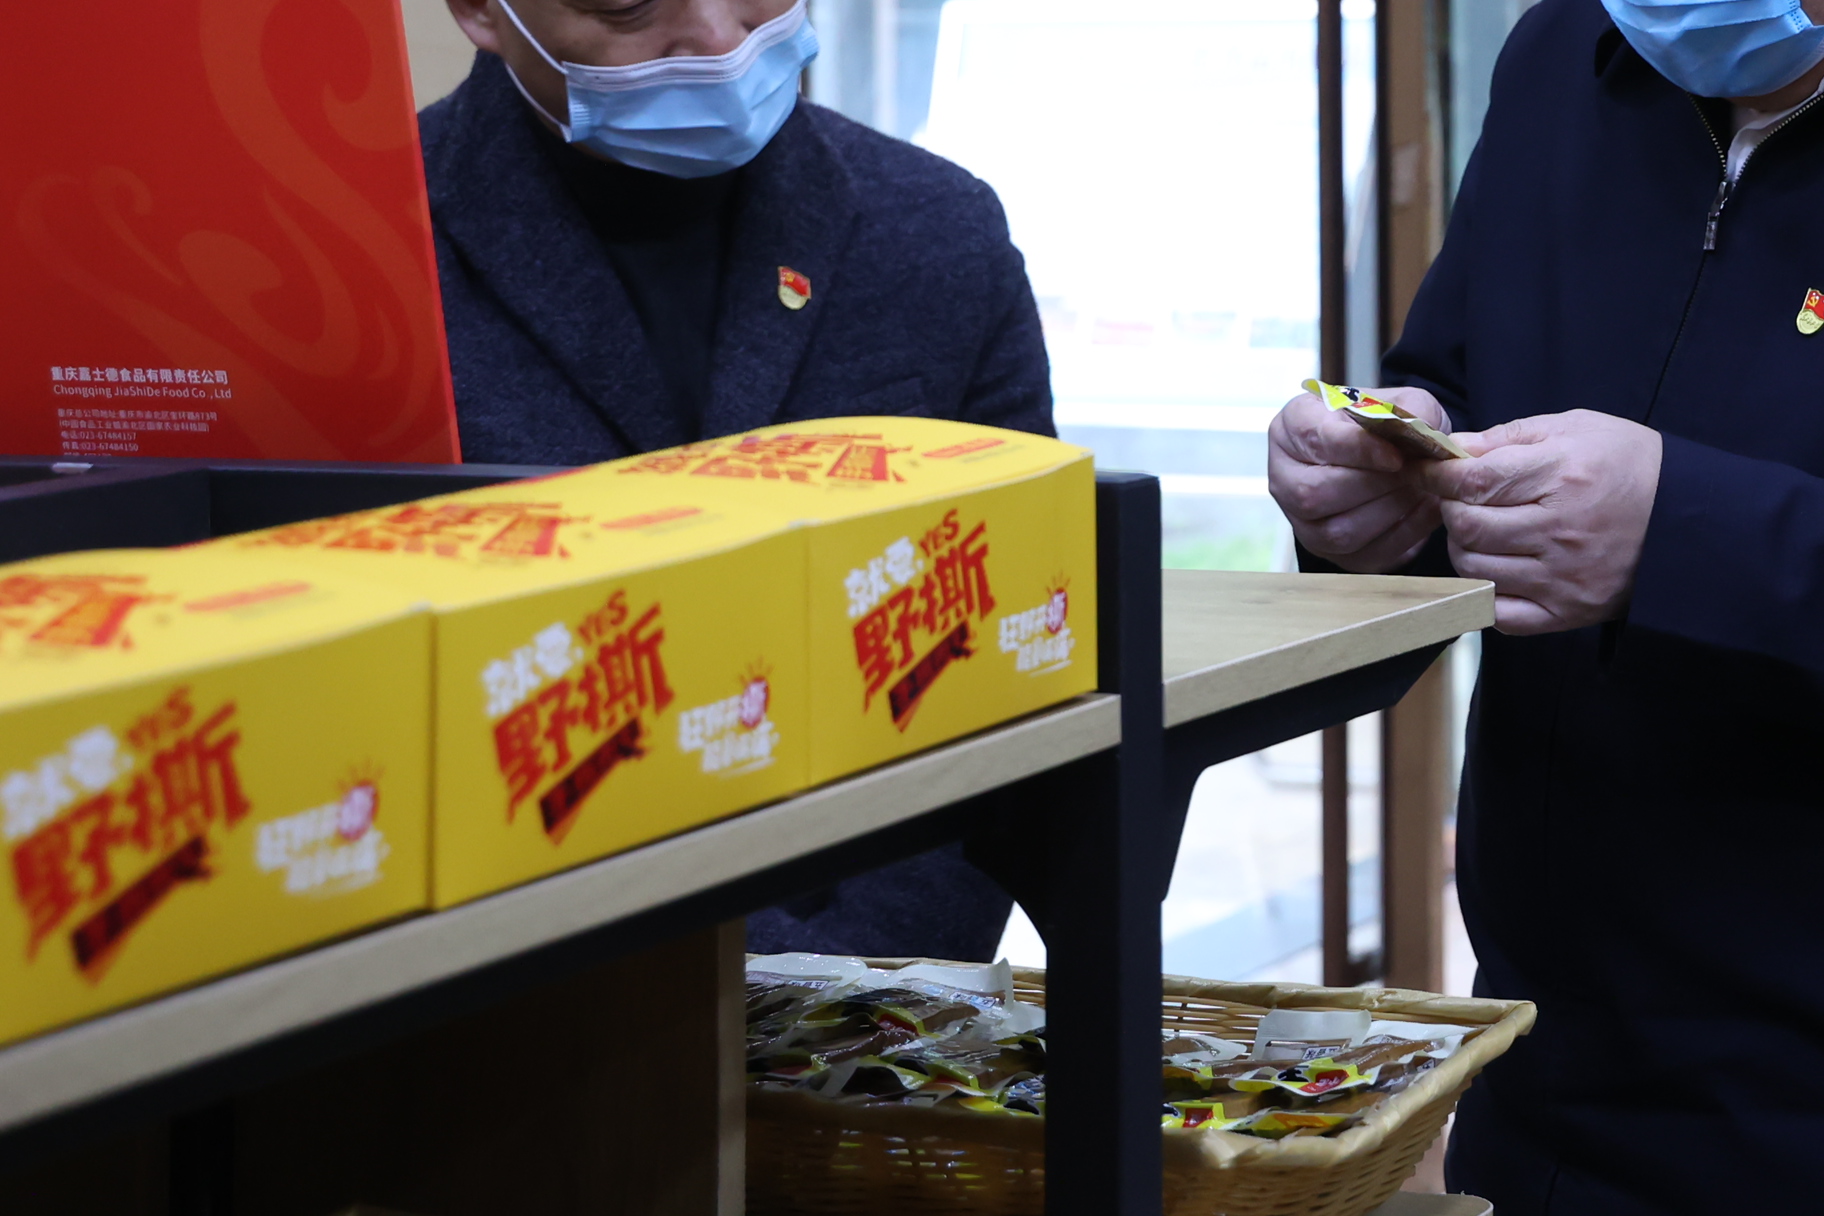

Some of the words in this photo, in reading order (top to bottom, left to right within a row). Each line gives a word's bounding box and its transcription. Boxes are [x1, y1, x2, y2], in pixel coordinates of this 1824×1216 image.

[51, 366, 228, 384] 重庆嘉士德食品有限责任公司
[53, 384, 112, 398] Chongqing
[114, 385, 161, 397] JiaShiDe
[163, 387, 189, 398] Food
[918, 508, 960, 558] YES
